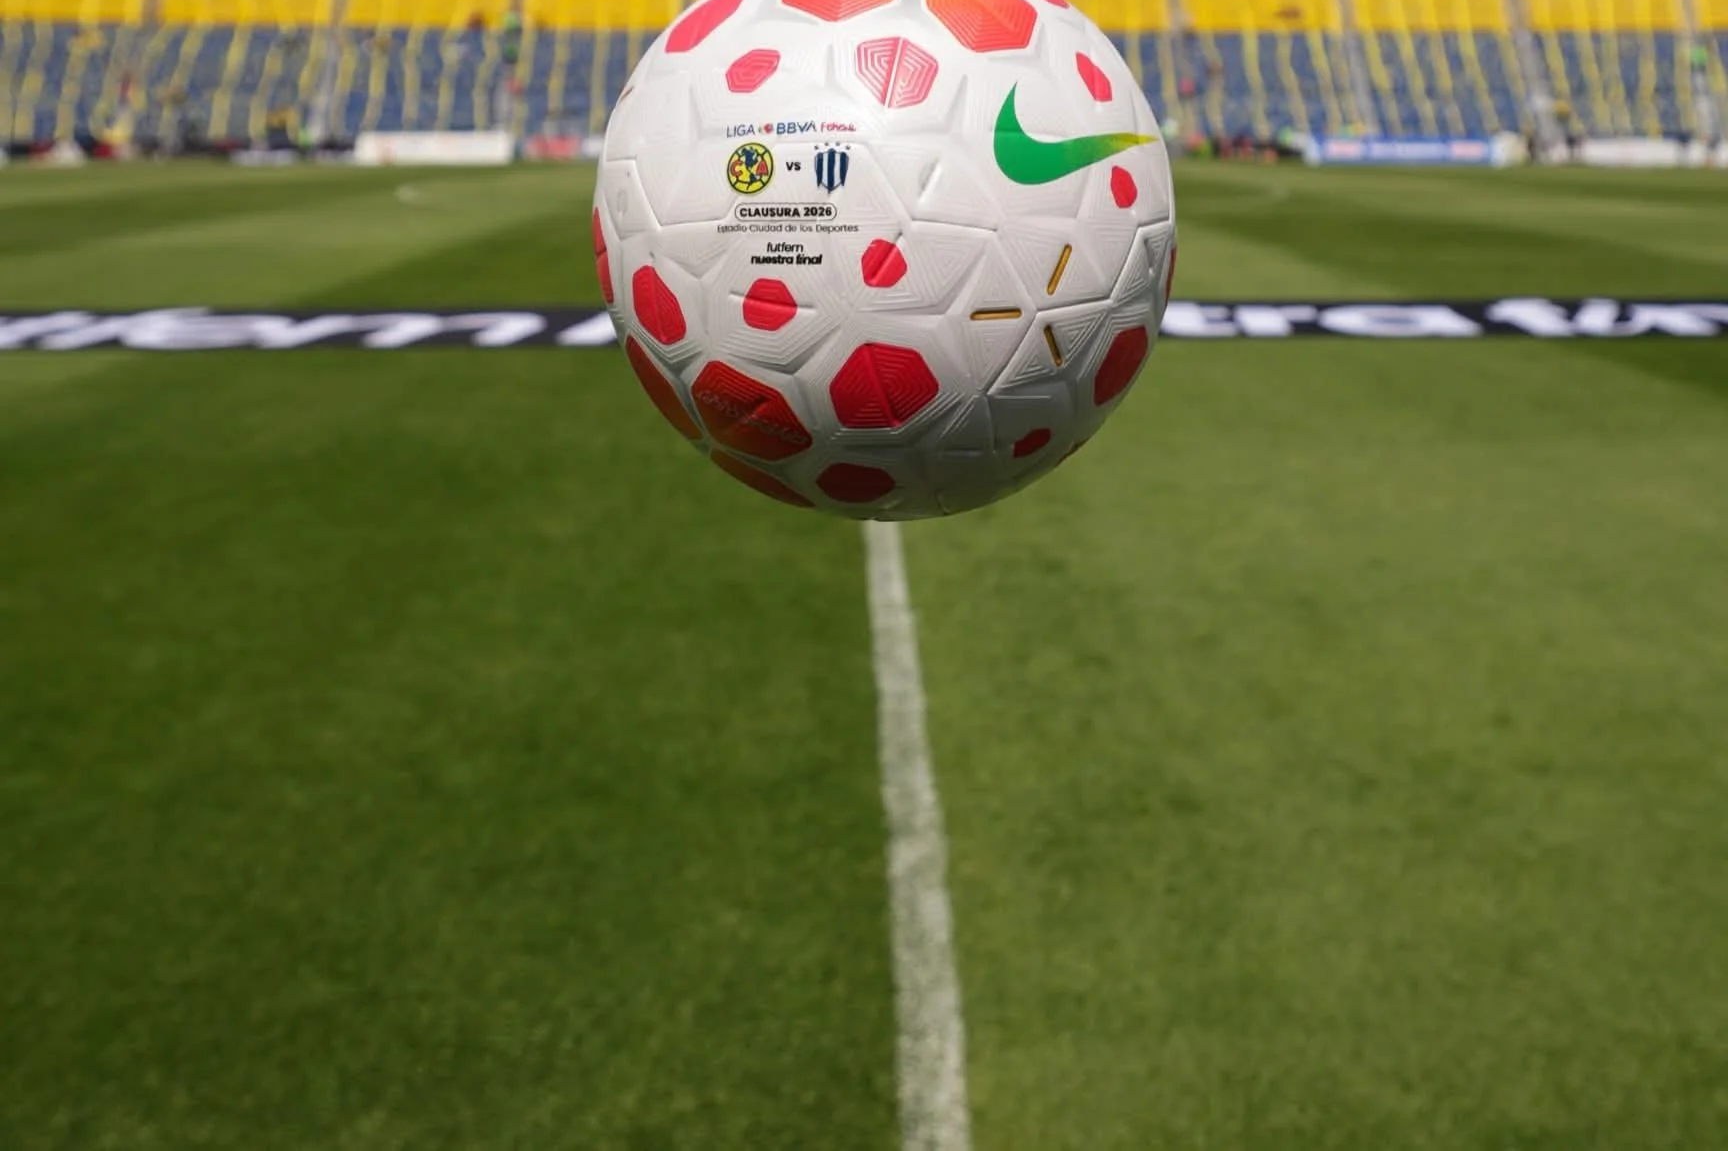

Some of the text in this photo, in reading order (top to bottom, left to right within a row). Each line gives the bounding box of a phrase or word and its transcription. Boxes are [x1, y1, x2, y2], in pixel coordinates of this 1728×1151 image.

[726, 124, 756, 138] LIGA
[776, 120, 817, 135] BBVA
[739, 206, 832, 217] CLAUSURA 2026
[717, 224, 859, 234] Estadio Ciudad de los Deportes
[751, 253, 823, 265] nuestra final
